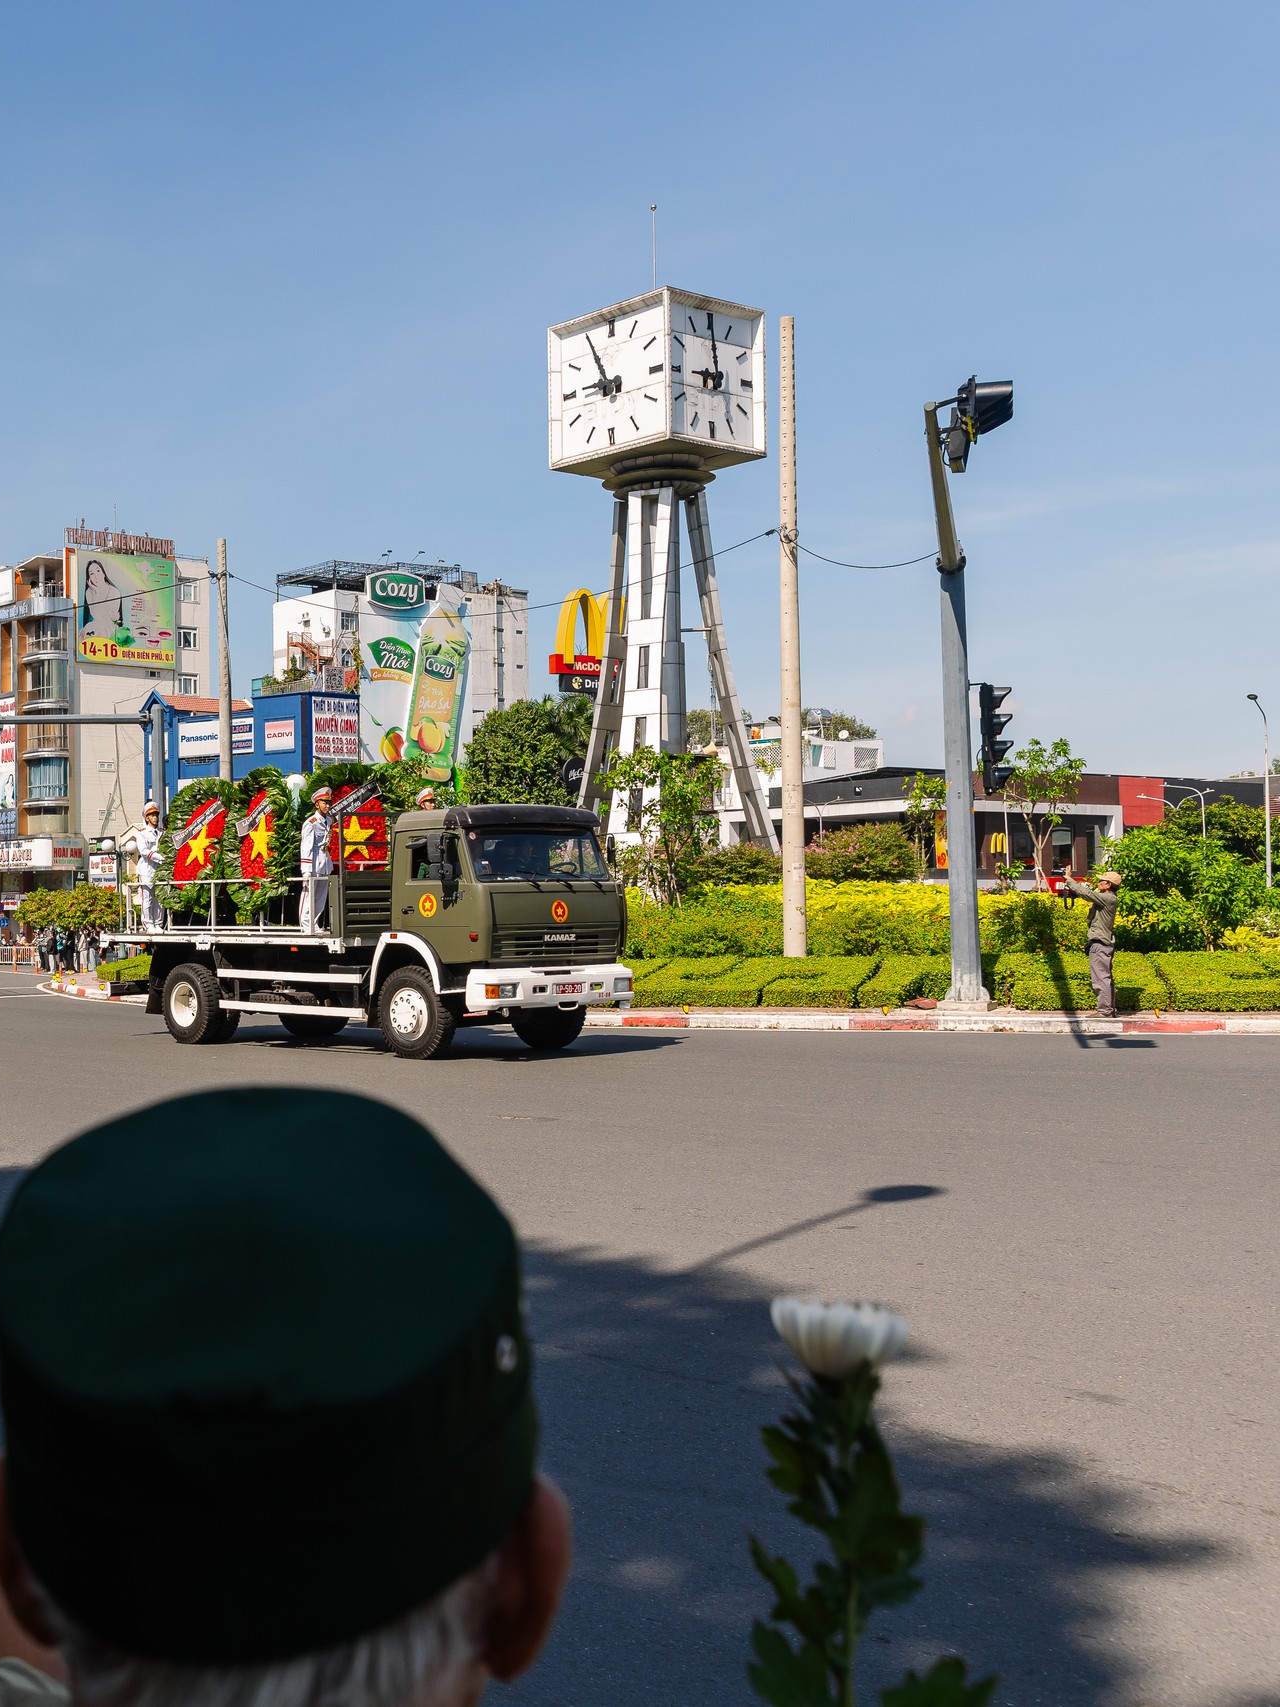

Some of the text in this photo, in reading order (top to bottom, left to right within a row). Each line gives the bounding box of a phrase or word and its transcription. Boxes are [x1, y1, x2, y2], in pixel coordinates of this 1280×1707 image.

[66, 518, 92, 545] THẨM
[156, 539, 174, 555] ANH
[376, 578, 418, 602] Cozy
[82, 641, 118, 658] 14-16
[122, 650, 135, 660] ĐIỆN
[136, 650, 150, 660] BIÊN
[380, 652, 410, 669] Mới
[426, 658, 454, 678] Cozy
[314, 713, 356, 734] NGUYỄN GIANG
[181, 732, 218, 743] Panasonic
[266, 732, 293, 740] CADIVI
[315, 736, 330, 744] 0906
[332, 737, 344, 745] 679
[1, 748, 14, 764] ANH
[315, 744, 330, 753] 0909
[344, 746, 357, 754] 300
[12, 848, 32, 862] ANH
[54, 846, 83, 858] HOÀI ANH
[544, 934, 576, 942] KAMAZ
